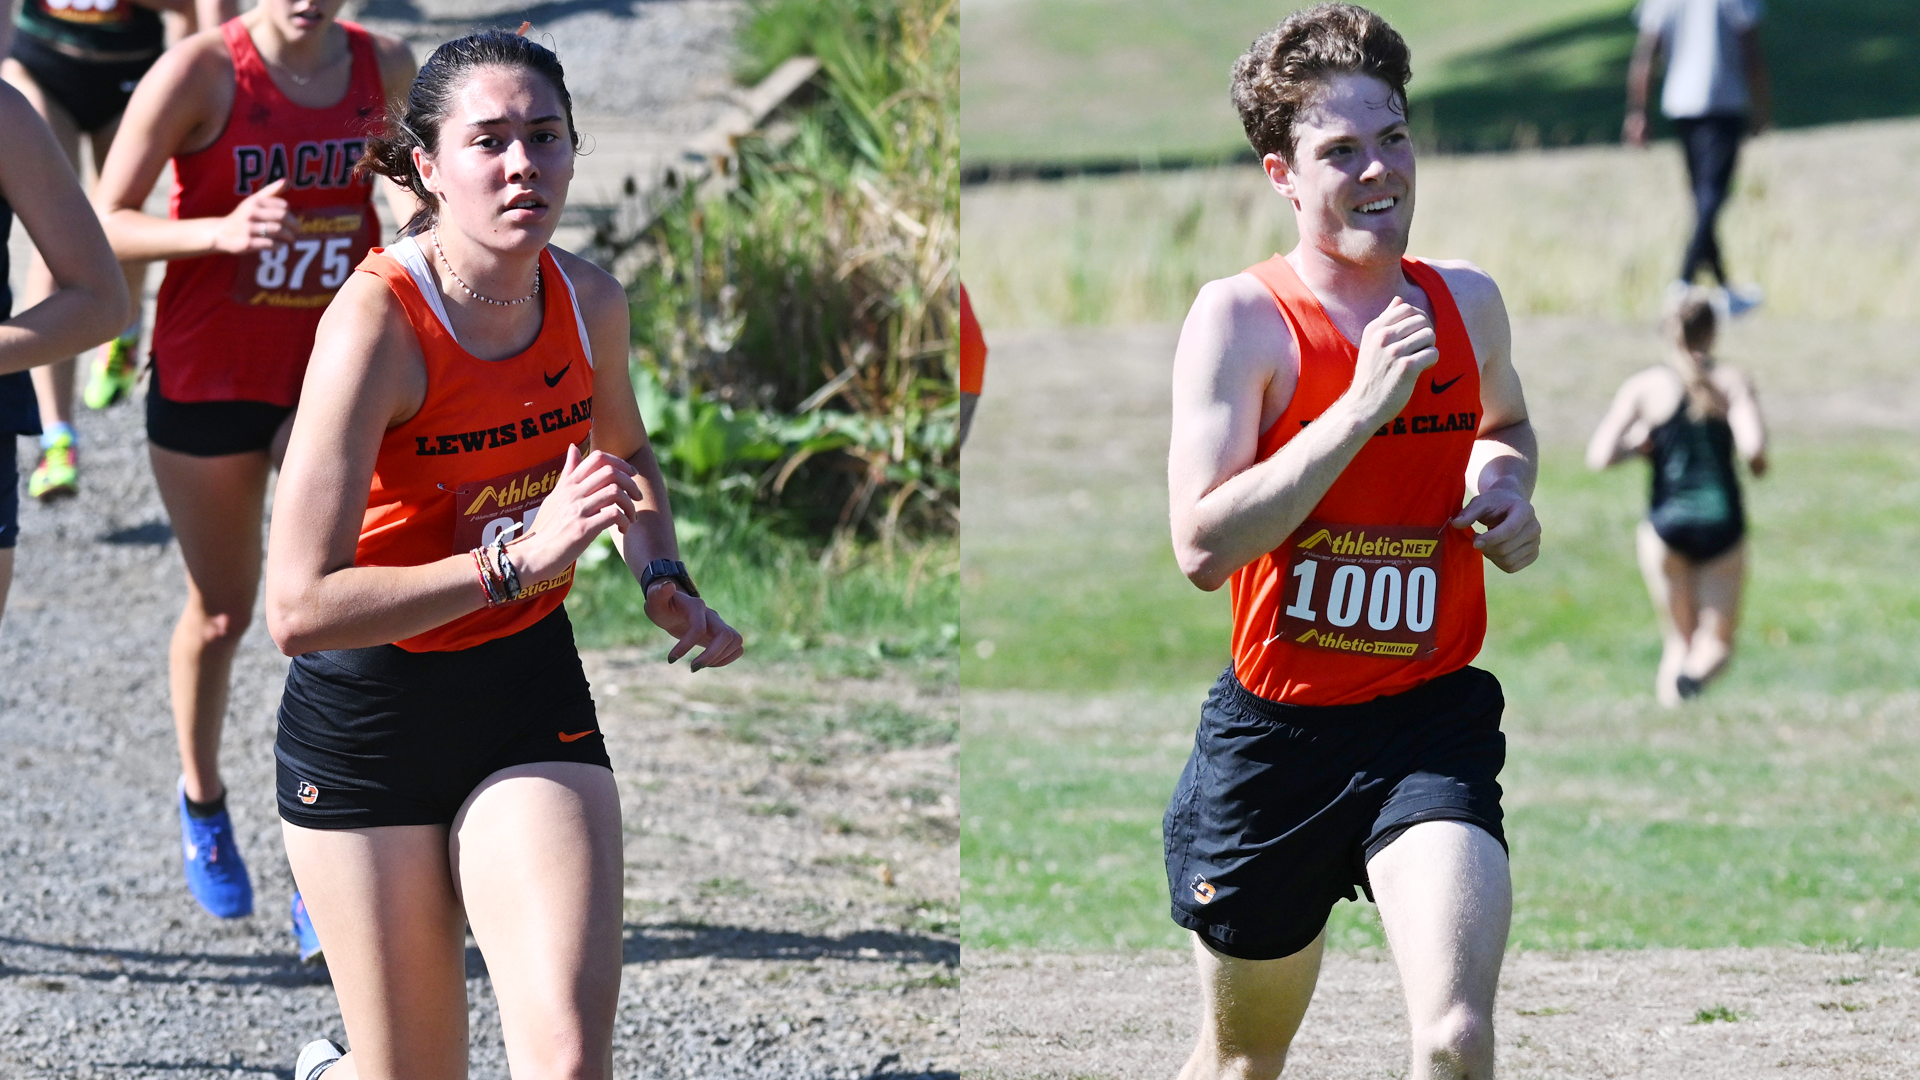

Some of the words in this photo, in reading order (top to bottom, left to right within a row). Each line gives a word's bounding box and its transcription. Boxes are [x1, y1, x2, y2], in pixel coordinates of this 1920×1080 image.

[233, 137, 371, 196] PACIF
[256, 237, 353, 291] 875
[415, 423, 518, 456] LEWIS
[520, 417, 540, 440] &
[1285, 559, 1437, 633] 1000
